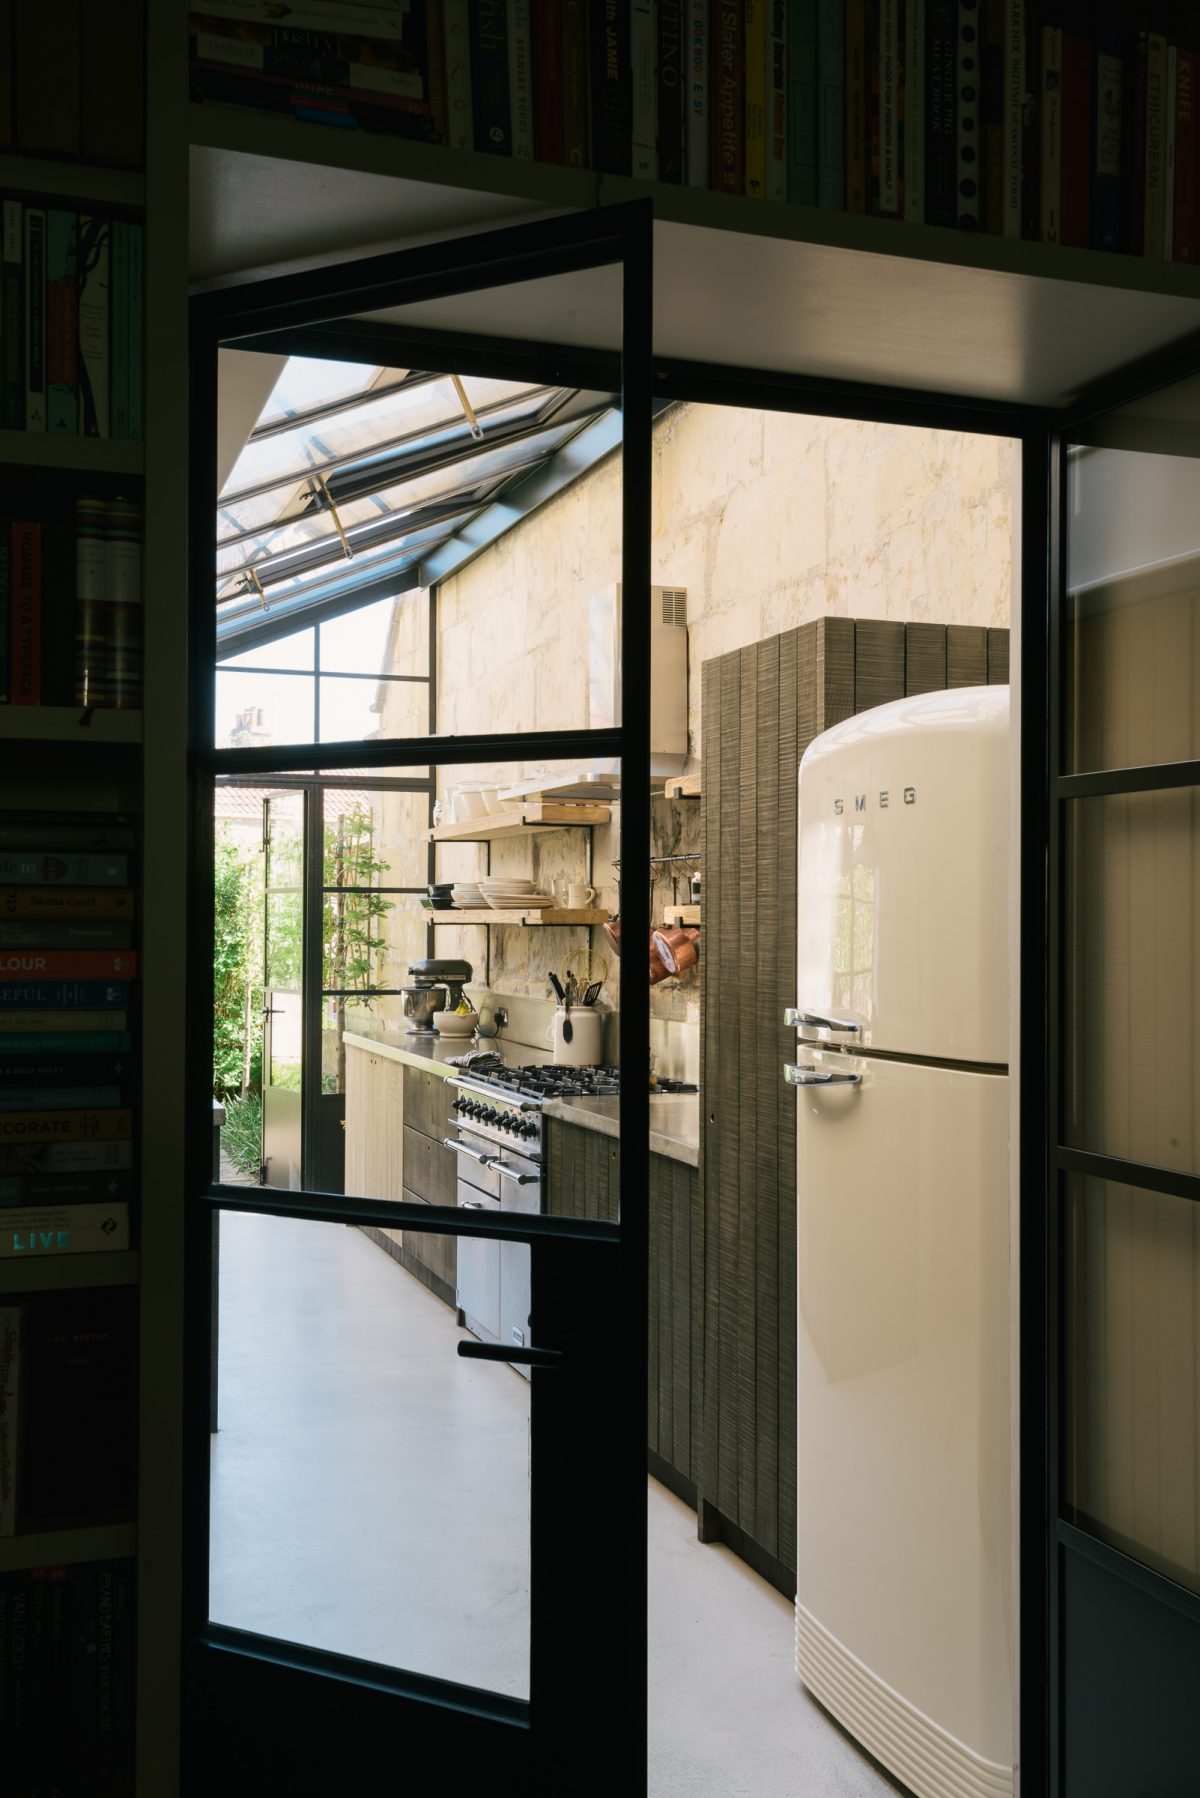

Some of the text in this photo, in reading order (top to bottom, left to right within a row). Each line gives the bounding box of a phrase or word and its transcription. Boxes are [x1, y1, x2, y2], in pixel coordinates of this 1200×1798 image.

[605, 27, 622, 80] JAMIE
[721, 11, 737, 72] Slater
[1176, 61, 1192, 120] KNIFE
[720, 74, 738, 165] Appetite
[1148, 73, 1162, 188] ETHICUREAN
[883, 157, 892, 191] FAMILY
[20, 530, 33, 697] HOMAGE TO A TYPEFACE
[834, 787, 916, 816] SMEG
[0, 957, 47, 971] LOUR
[12, 1231, 71, 1251] LIVE
